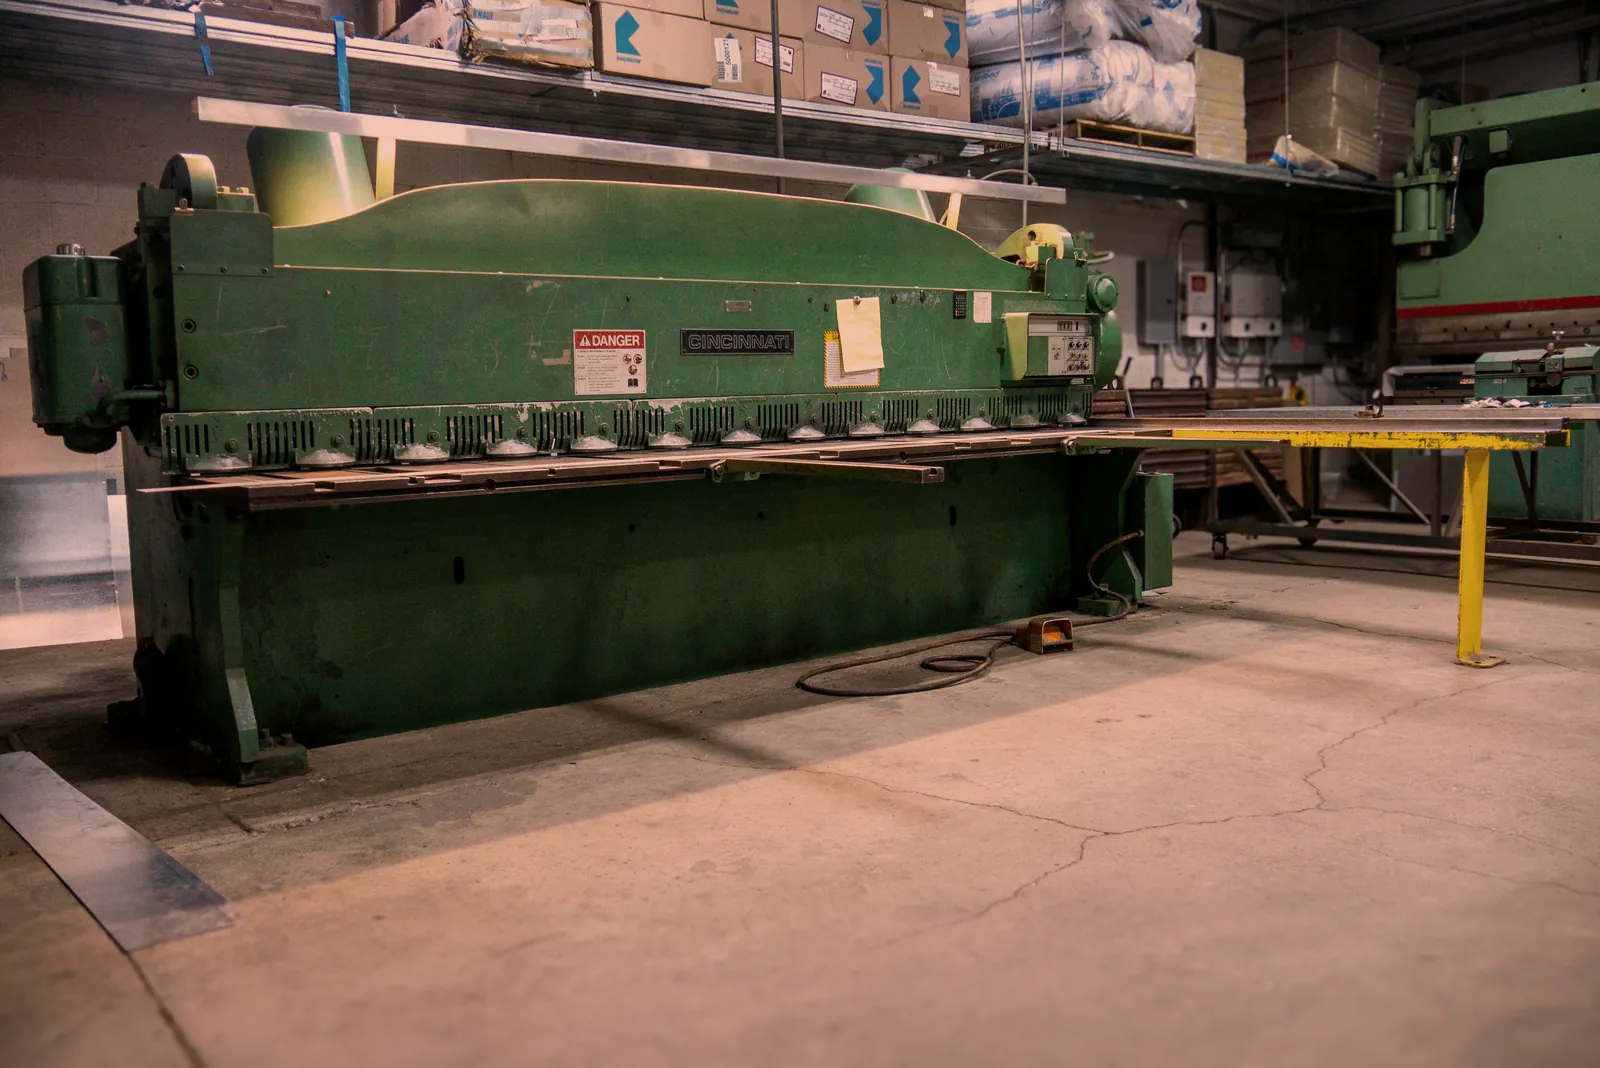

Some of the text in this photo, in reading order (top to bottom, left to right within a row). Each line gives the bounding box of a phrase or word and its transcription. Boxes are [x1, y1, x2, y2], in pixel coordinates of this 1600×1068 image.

[473, 8, 493, 20] KNAUF
[591, 334, 640, 346] DANGER
[688, 334, 790, 350] CINCINNATI
